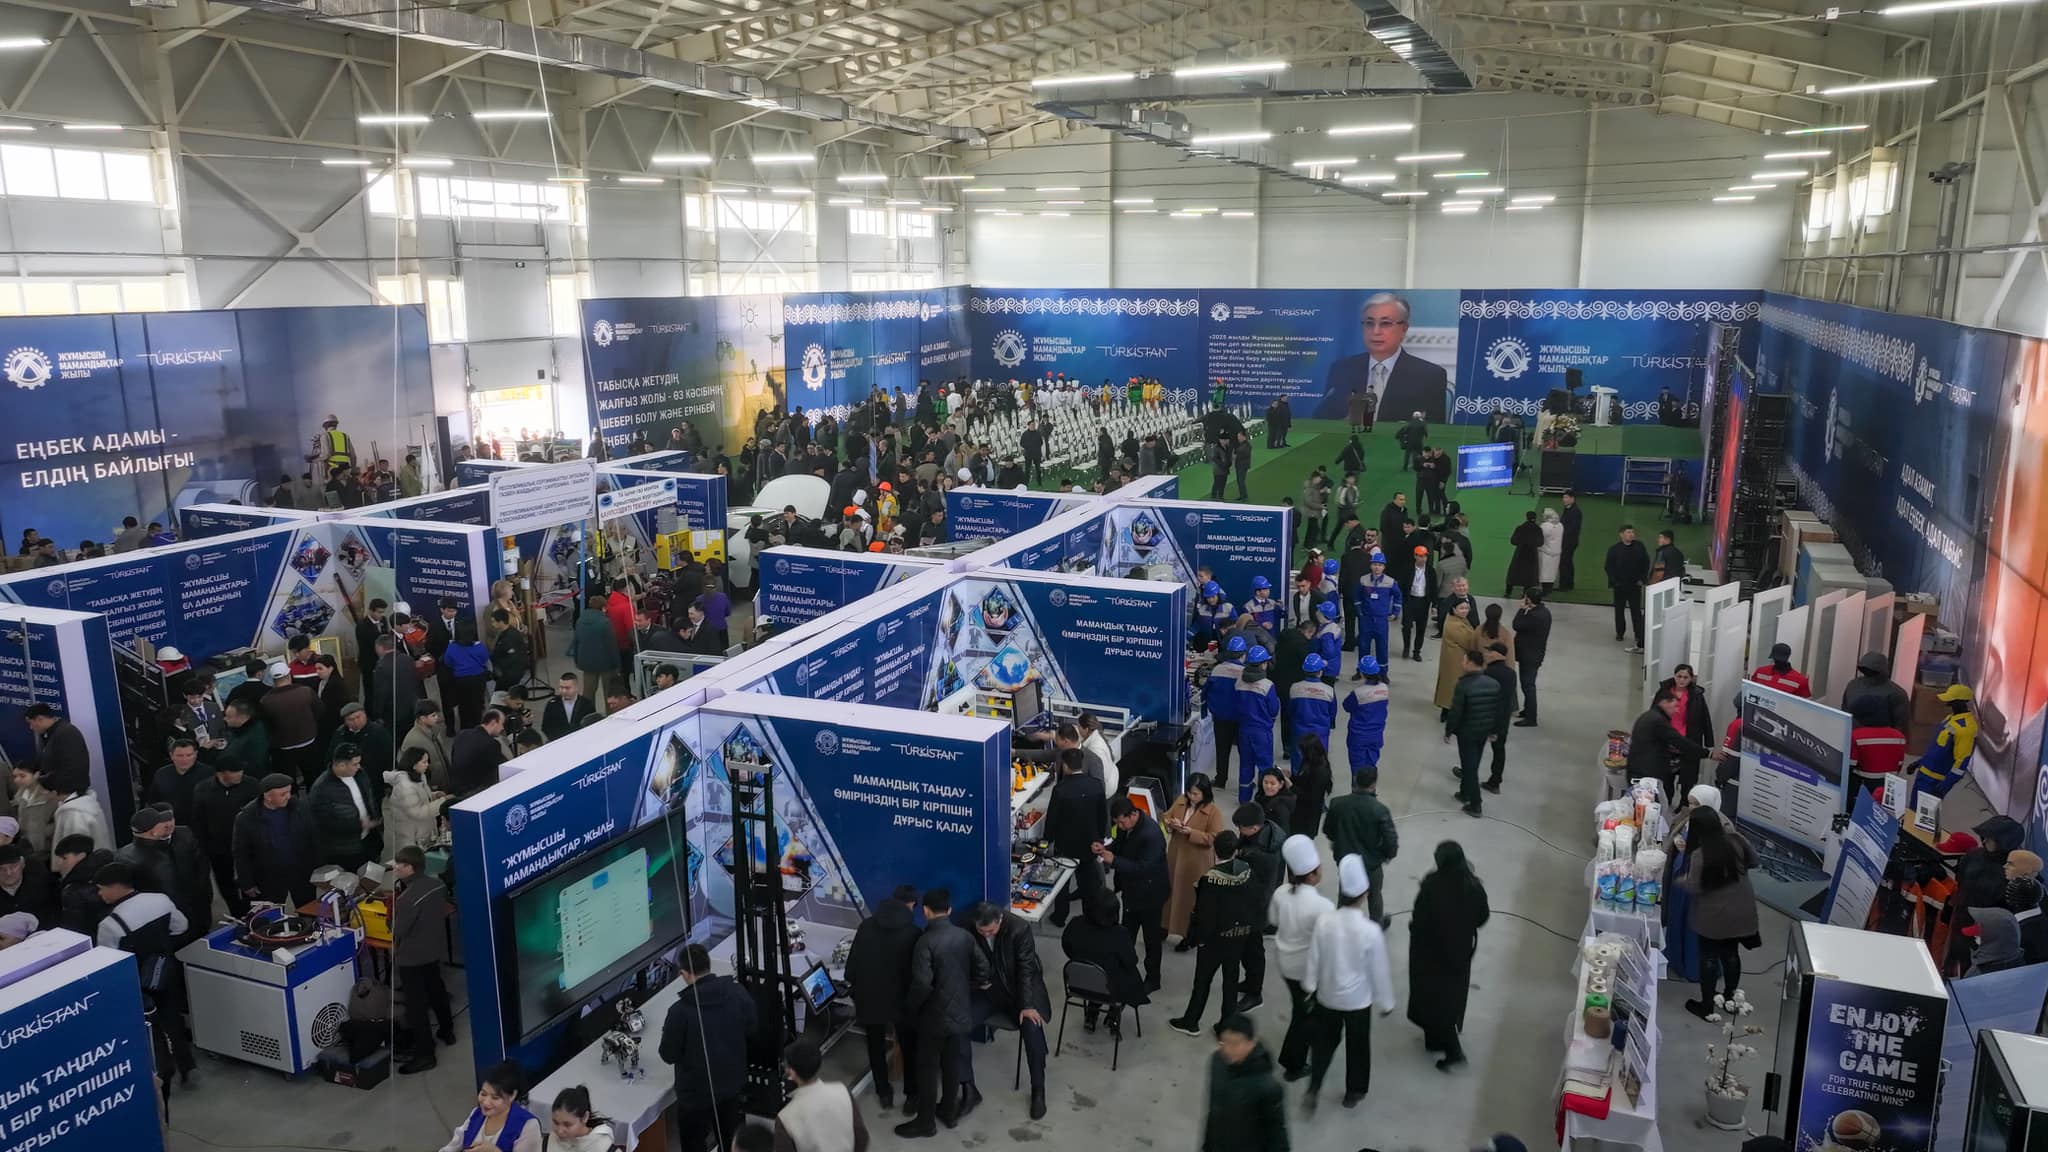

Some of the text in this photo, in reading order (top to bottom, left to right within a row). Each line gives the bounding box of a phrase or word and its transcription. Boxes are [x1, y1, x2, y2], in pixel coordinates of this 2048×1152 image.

[1539, 355, 1609, 365] МАМАНДЫҚТАР
[597, 373, 680, 392] ТАБЫСҚА ЖЕТУДІҢ
[599, 396, 638, 411] ЖАЛҒЫЗ
[640, 392, 666, 405] ЖОЛЫ
[600, 401, 716, 429] ШЕБЕРІ БОЛУ ЖӘНЕ ЕРІНБЕЙ
[16, 437, 86, 460] ЕҢБЕК
[92, 429, 166, 453] АДАМЫ
[20, 452, 196, 488] ЕЛДІҢ БАЙЛЫҒЫ!
[1076, 619, 1125, 632] МАМАНДЫҚ
[1125, 623, 1159, 634] ТАҢДАУ
[1111, 635, 1124, 644] БІР
[1104, 647, 1163, 660] ДҰРЫС ҚАЛАУ
[853, 773, 920, 794] МАМАНДЫҚ
[920, 782, 966, 799] ТАҢДАУ
[833, 788, 973, 817] ӨМІРІҢІЗДІҢ БІР КІРПІШІН
[583, 818, 615, 845] ЖЫЛЫ
[893, 814, 973, 835] ДҰРЫС ҚАЛАУ
[1829, 1003, 1919, 1037] ENJOY
[1850, 1028, 1904, 1058] THE
[41, 1038, 116, 1086] ТАҢДАУ
[1839, 1050, 1919, 1084] GAME
[10, 1058, 132, 1133] БІР КІРПІШІН
[1821, 1083, 1880, 1102] CELEBRATING
[1828, 1074, 1916, 1099] FOR TRUE FANS AND
[4, 1084, 135, 1152] ҰРЫС ҚАЛАУ
